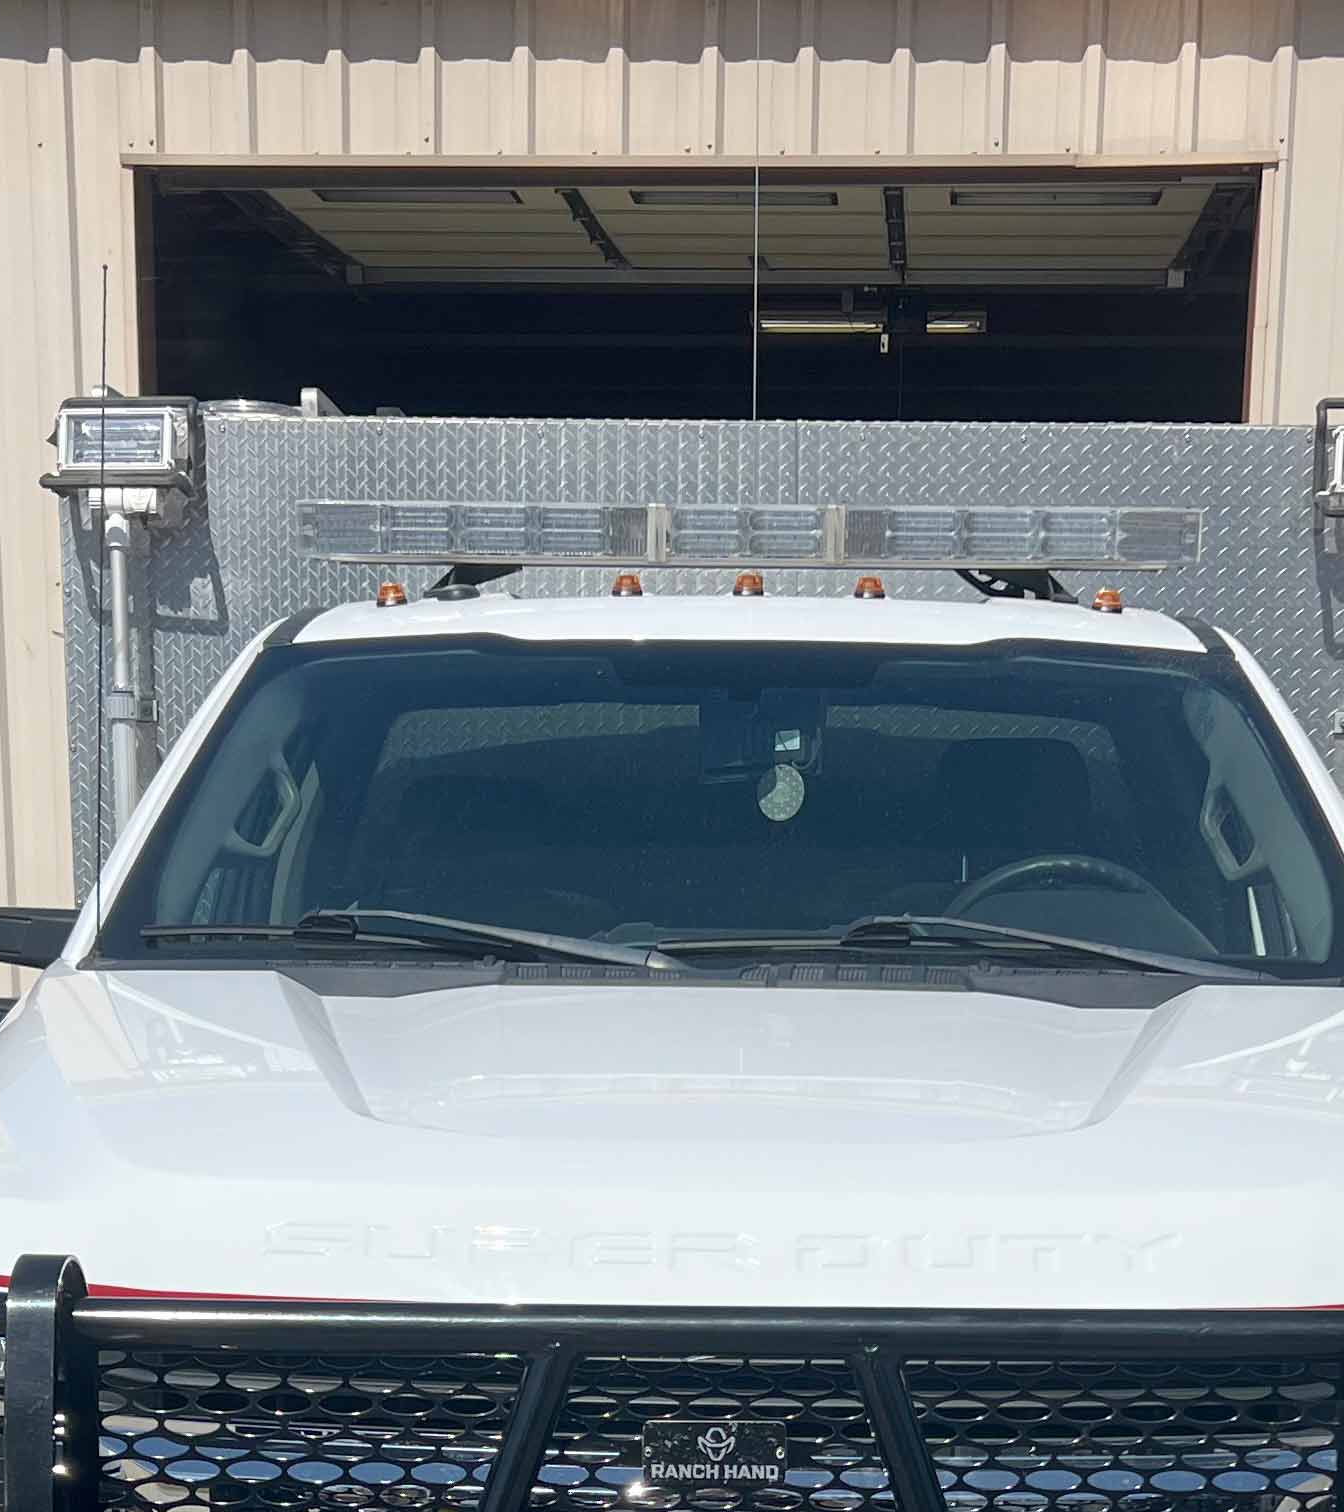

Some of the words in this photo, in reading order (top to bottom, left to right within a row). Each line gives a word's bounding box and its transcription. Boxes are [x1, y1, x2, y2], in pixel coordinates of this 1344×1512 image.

[263, 1218, 760, 1273] SUPER
[795, 1228, 1183, 1273] DUTY
[650, 1463, 720, 1480] RANCH
[723, 1463, 779, 1481] HAND
